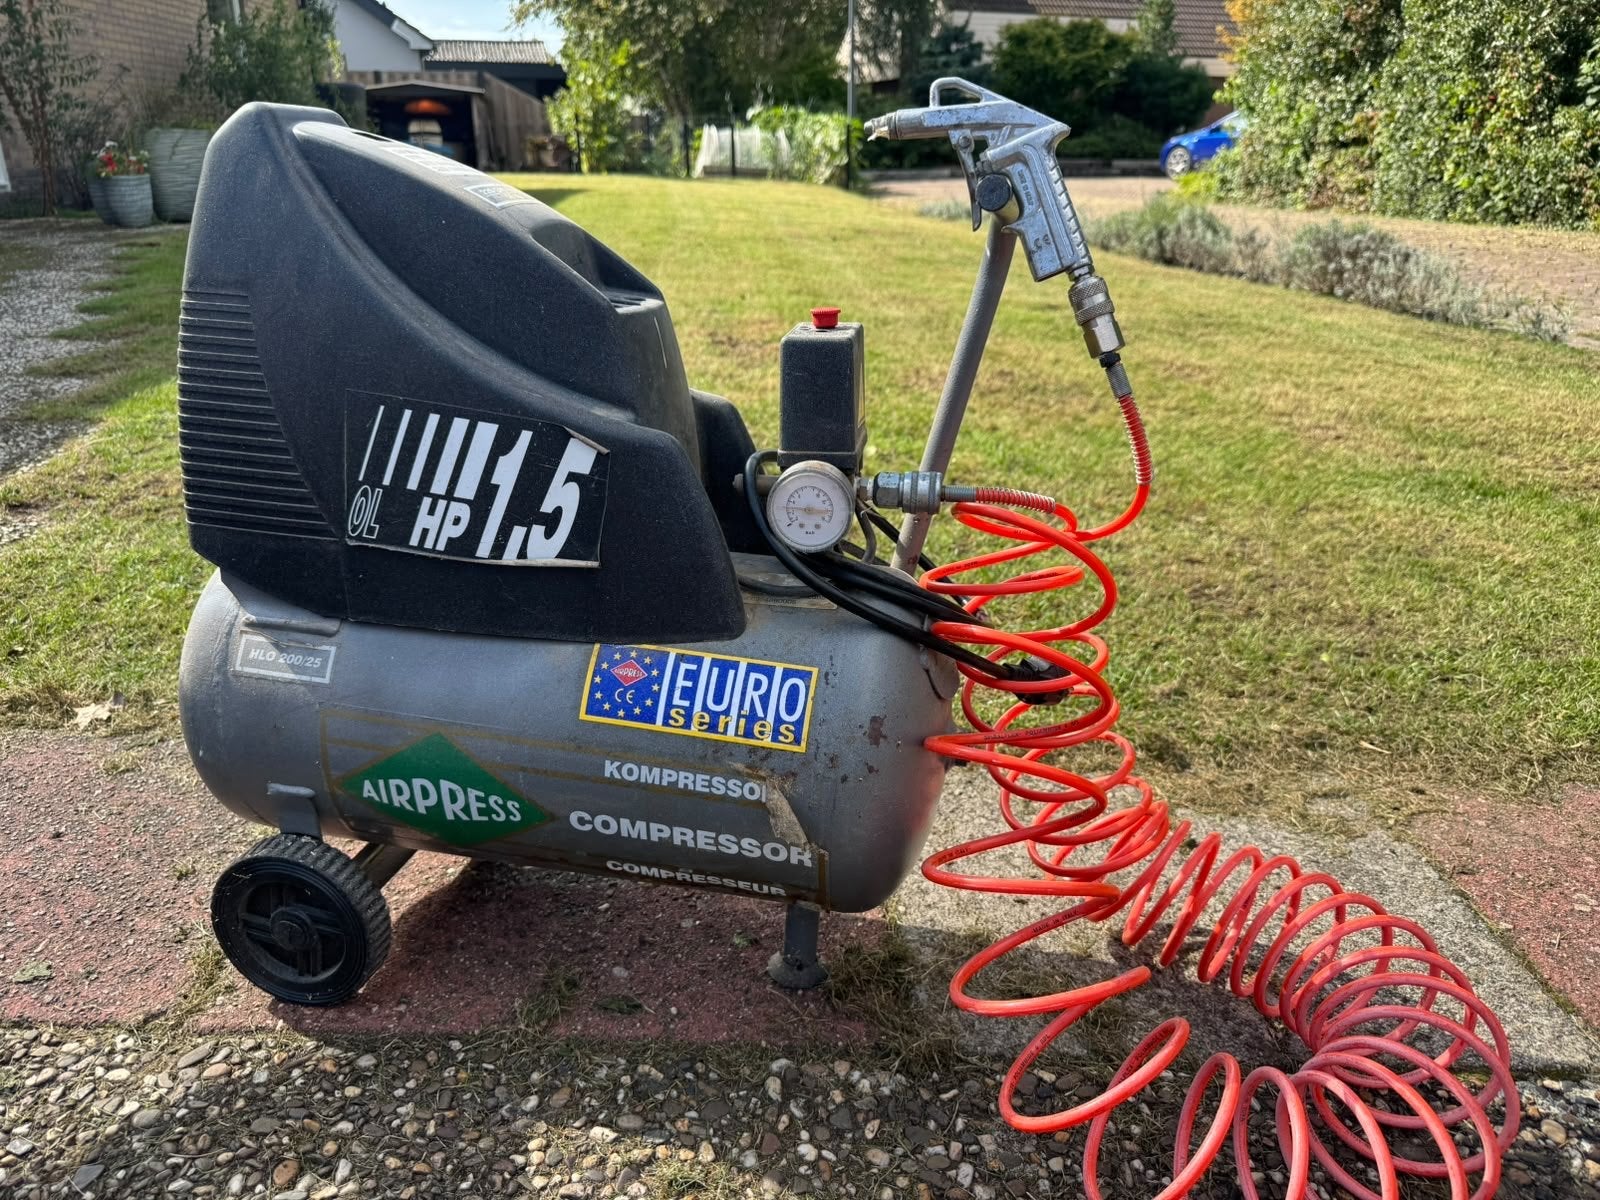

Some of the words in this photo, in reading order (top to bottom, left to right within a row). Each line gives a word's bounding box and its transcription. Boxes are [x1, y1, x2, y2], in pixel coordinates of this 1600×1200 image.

[409, 496, 471, 551] HP
[248, 648, 276, 661] HLO
[278, 653, 322, 668] 200/25
[672, 662, 806, 722] EURO
[669, 708, 796, 743] series
[362, 778, 522, 822] AIRPRESS
[569, 810, 813, 867] COMPRESSOR
[606, 860, 787, 897] COMPRESSEUR
